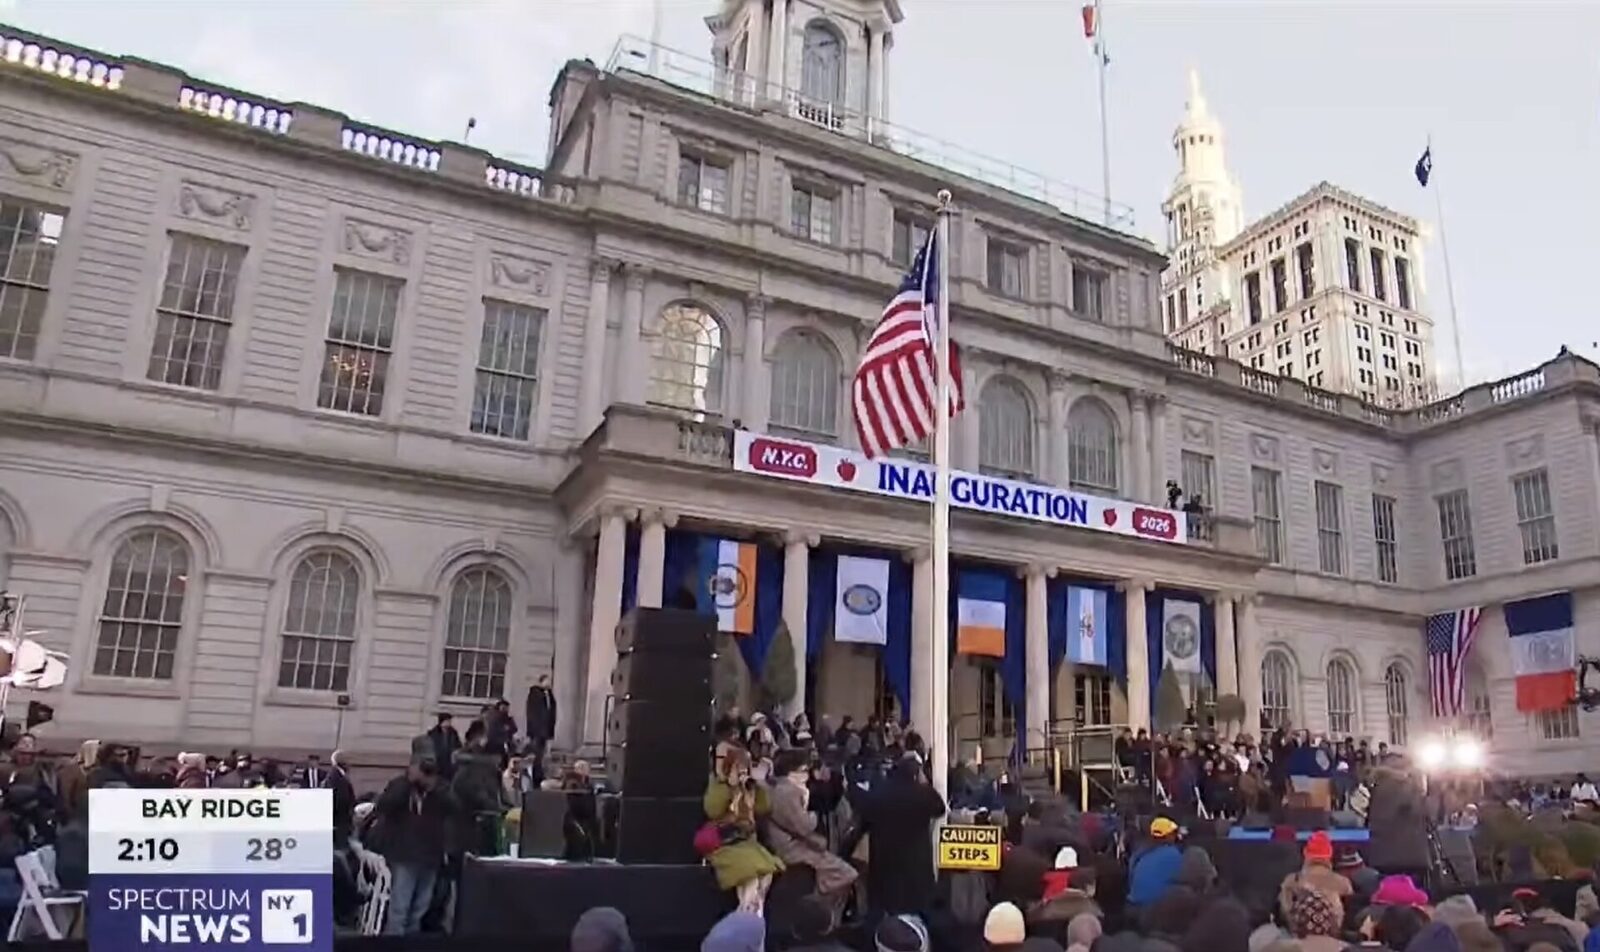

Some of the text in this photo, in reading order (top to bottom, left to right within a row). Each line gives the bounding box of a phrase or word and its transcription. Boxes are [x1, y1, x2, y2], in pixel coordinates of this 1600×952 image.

[761, 446, 1170, 532] N.Y.C. INAGURATION 2026
[942, 829, 997, 842] CAUTION
[949, 847, 990, 861] STEPS
